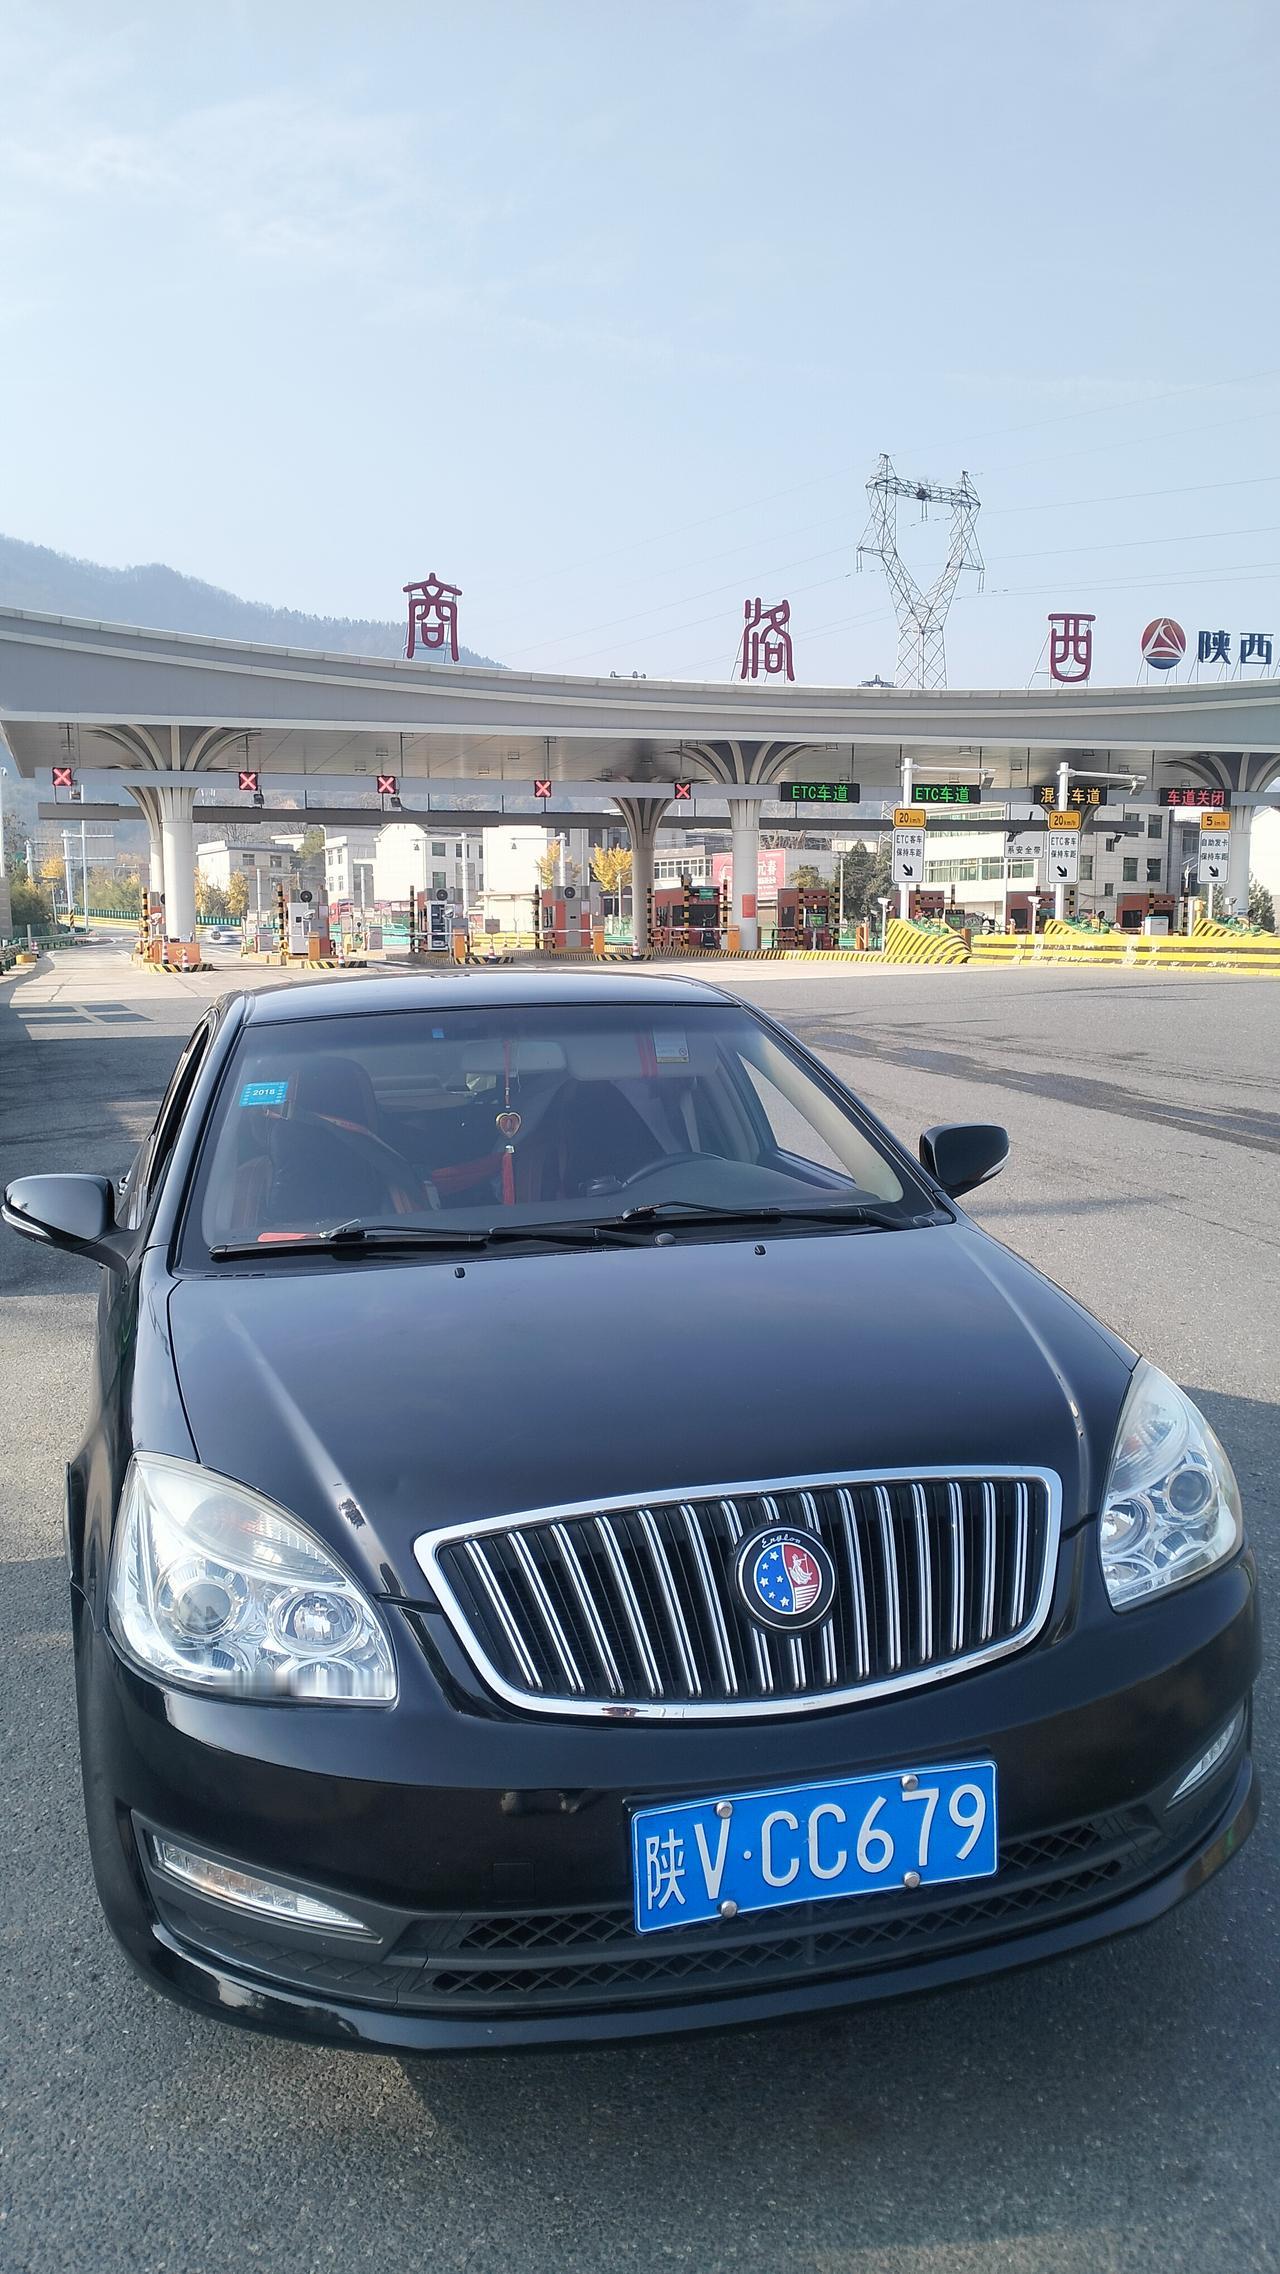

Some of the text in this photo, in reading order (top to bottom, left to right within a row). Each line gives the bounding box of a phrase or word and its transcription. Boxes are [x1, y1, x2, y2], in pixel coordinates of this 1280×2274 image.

[791, 784, 849, 802] ETC车道
[915, 784, 970, 803] ETC车道
[1040, 786, 1101, 804] 混车道
[1167, 789, 1225, 806] 车道关闭
